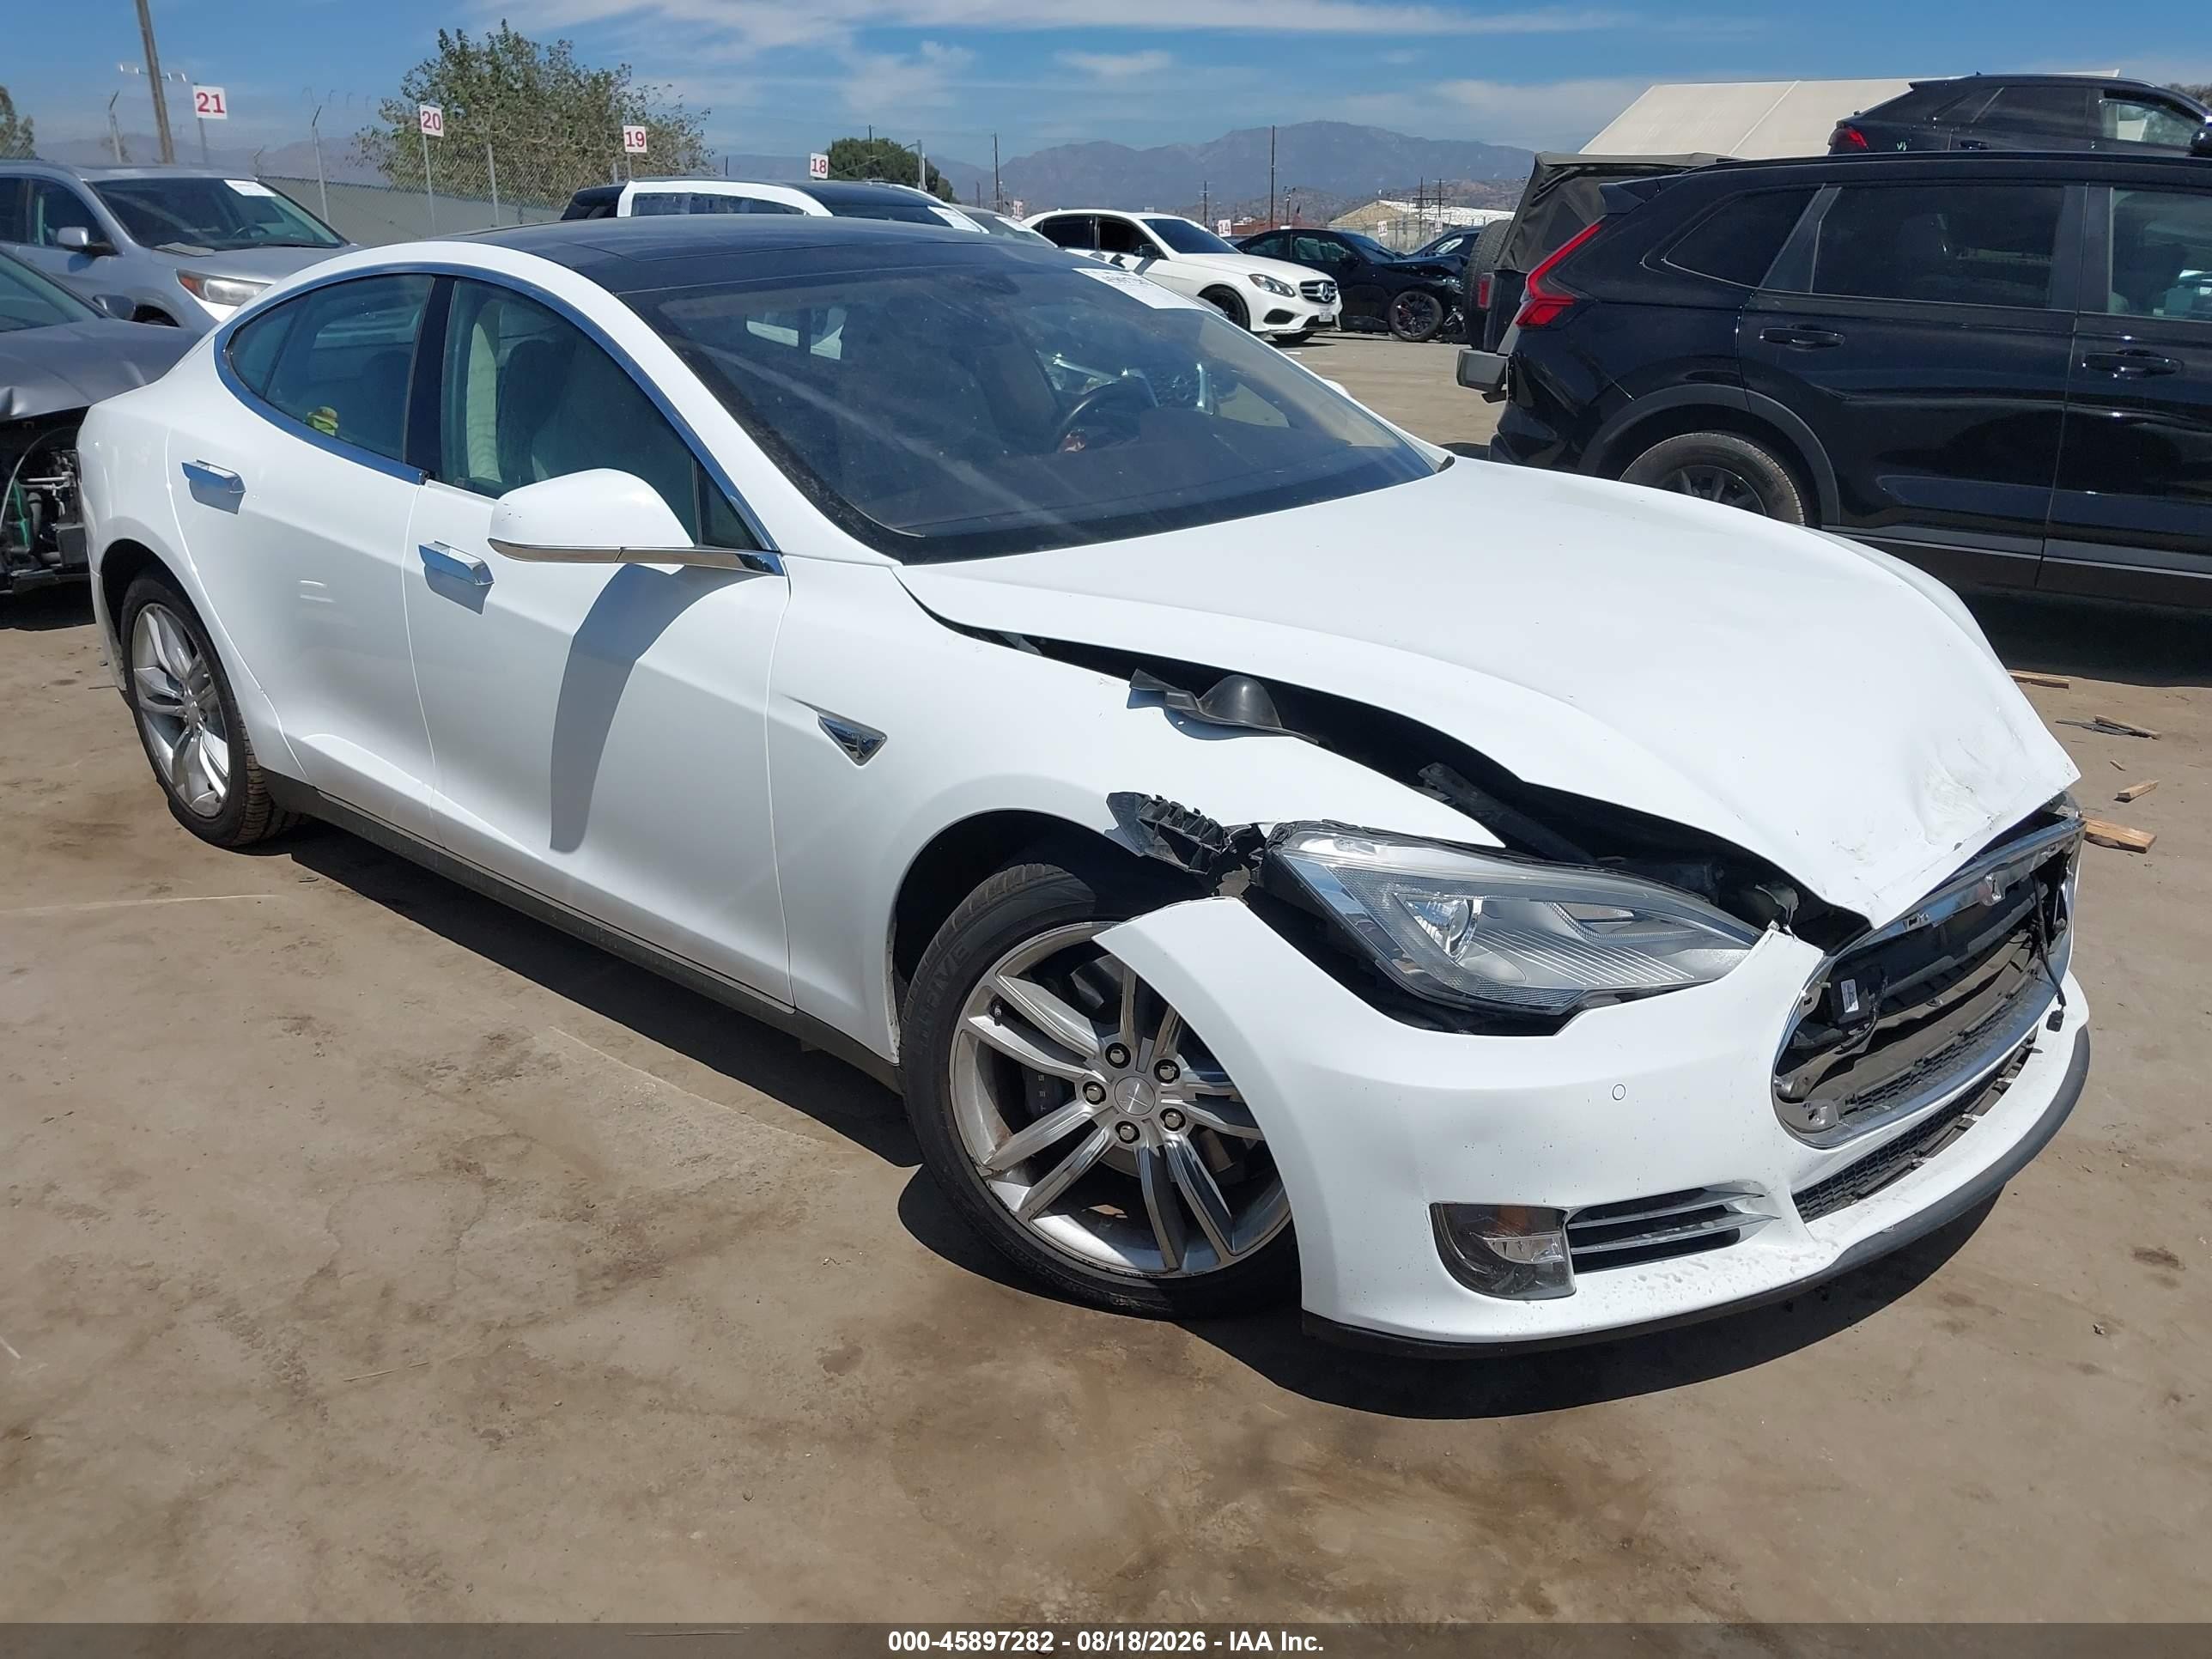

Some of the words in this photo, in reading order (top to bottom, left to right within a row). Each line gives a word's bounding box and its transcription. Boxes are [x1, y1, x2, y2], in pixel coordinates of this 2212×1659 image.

[196, 92, 225, 113] 21
[422, 111, 441, 131] 20
[625, 131, 645, 148] 19
[811, 158, 827, 173] 18
[1219, 223, 1230, 234] 14
[1377, 224, 1387, 234] 12
